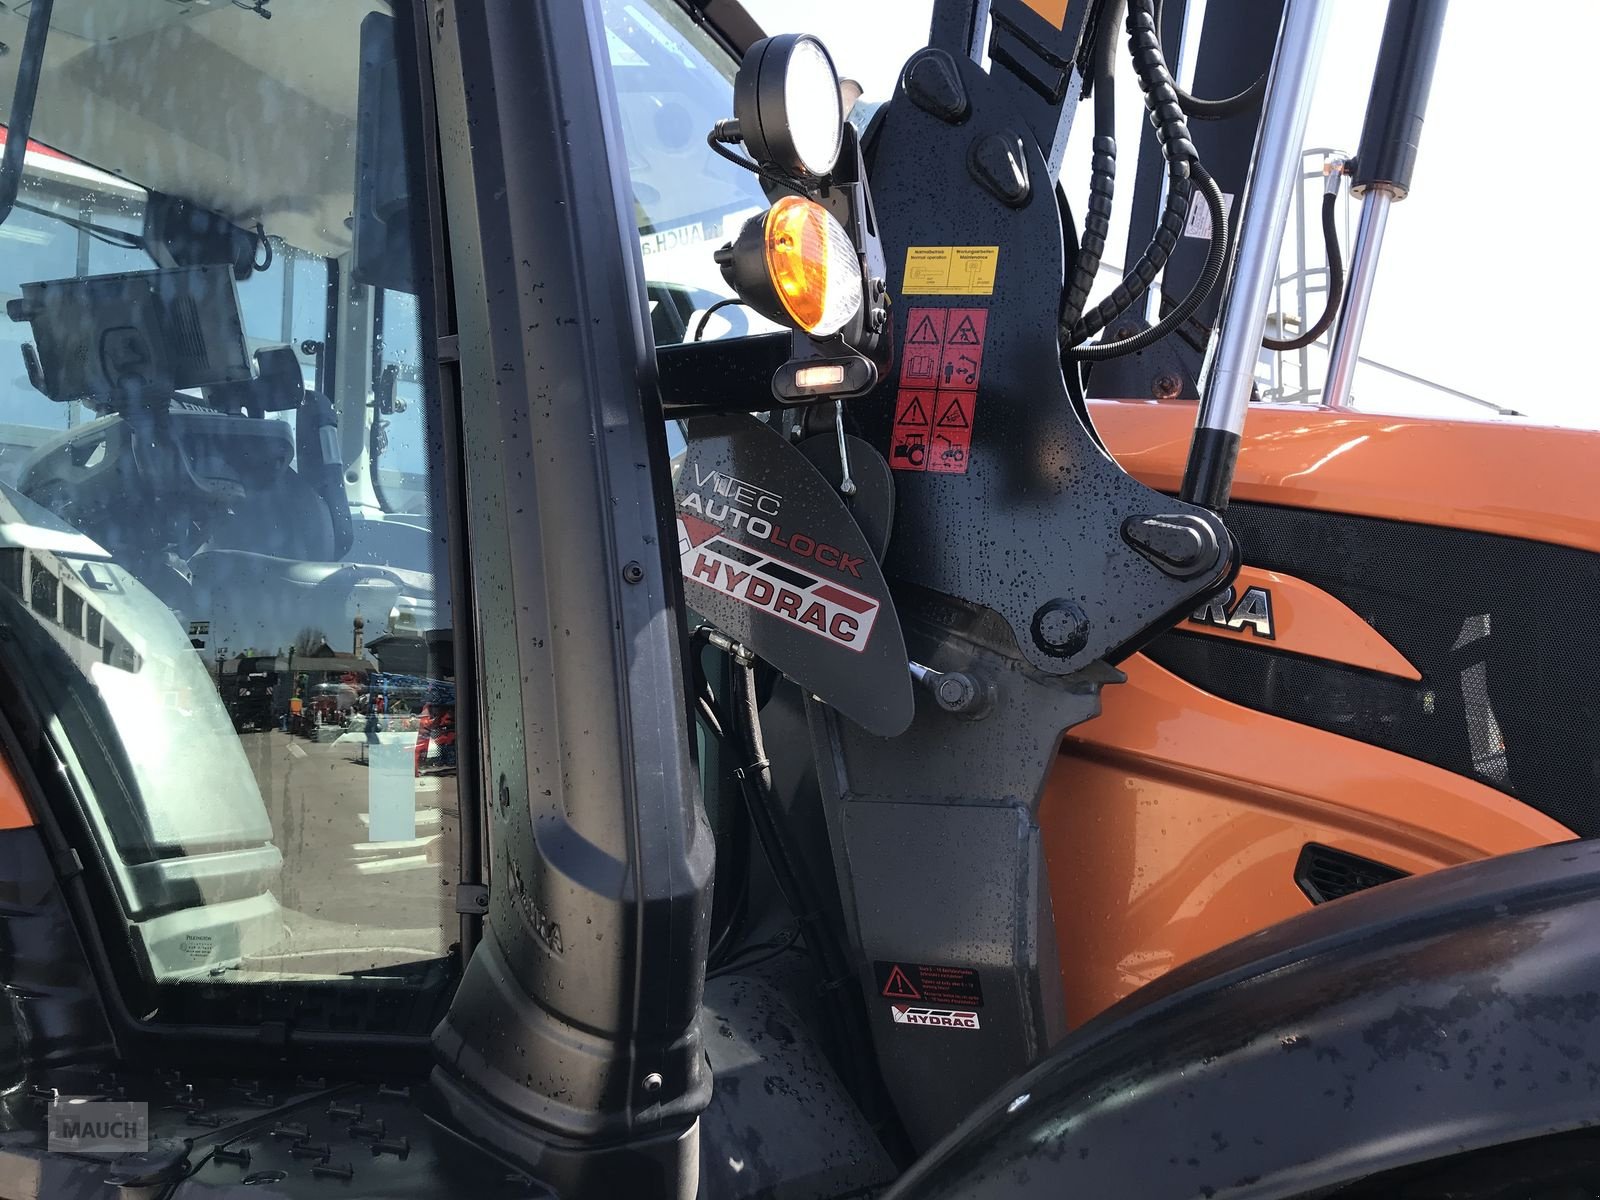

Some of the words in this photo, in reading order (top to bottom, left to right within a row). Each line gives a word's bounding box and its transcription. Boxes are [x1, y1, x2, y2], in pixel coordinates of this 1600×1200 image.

[680, 492, 865, 580] AUTOLOCK
[692, 553, 859, 642] HYDRAC
[906, 1014, 976, 1028] HYDRAC
